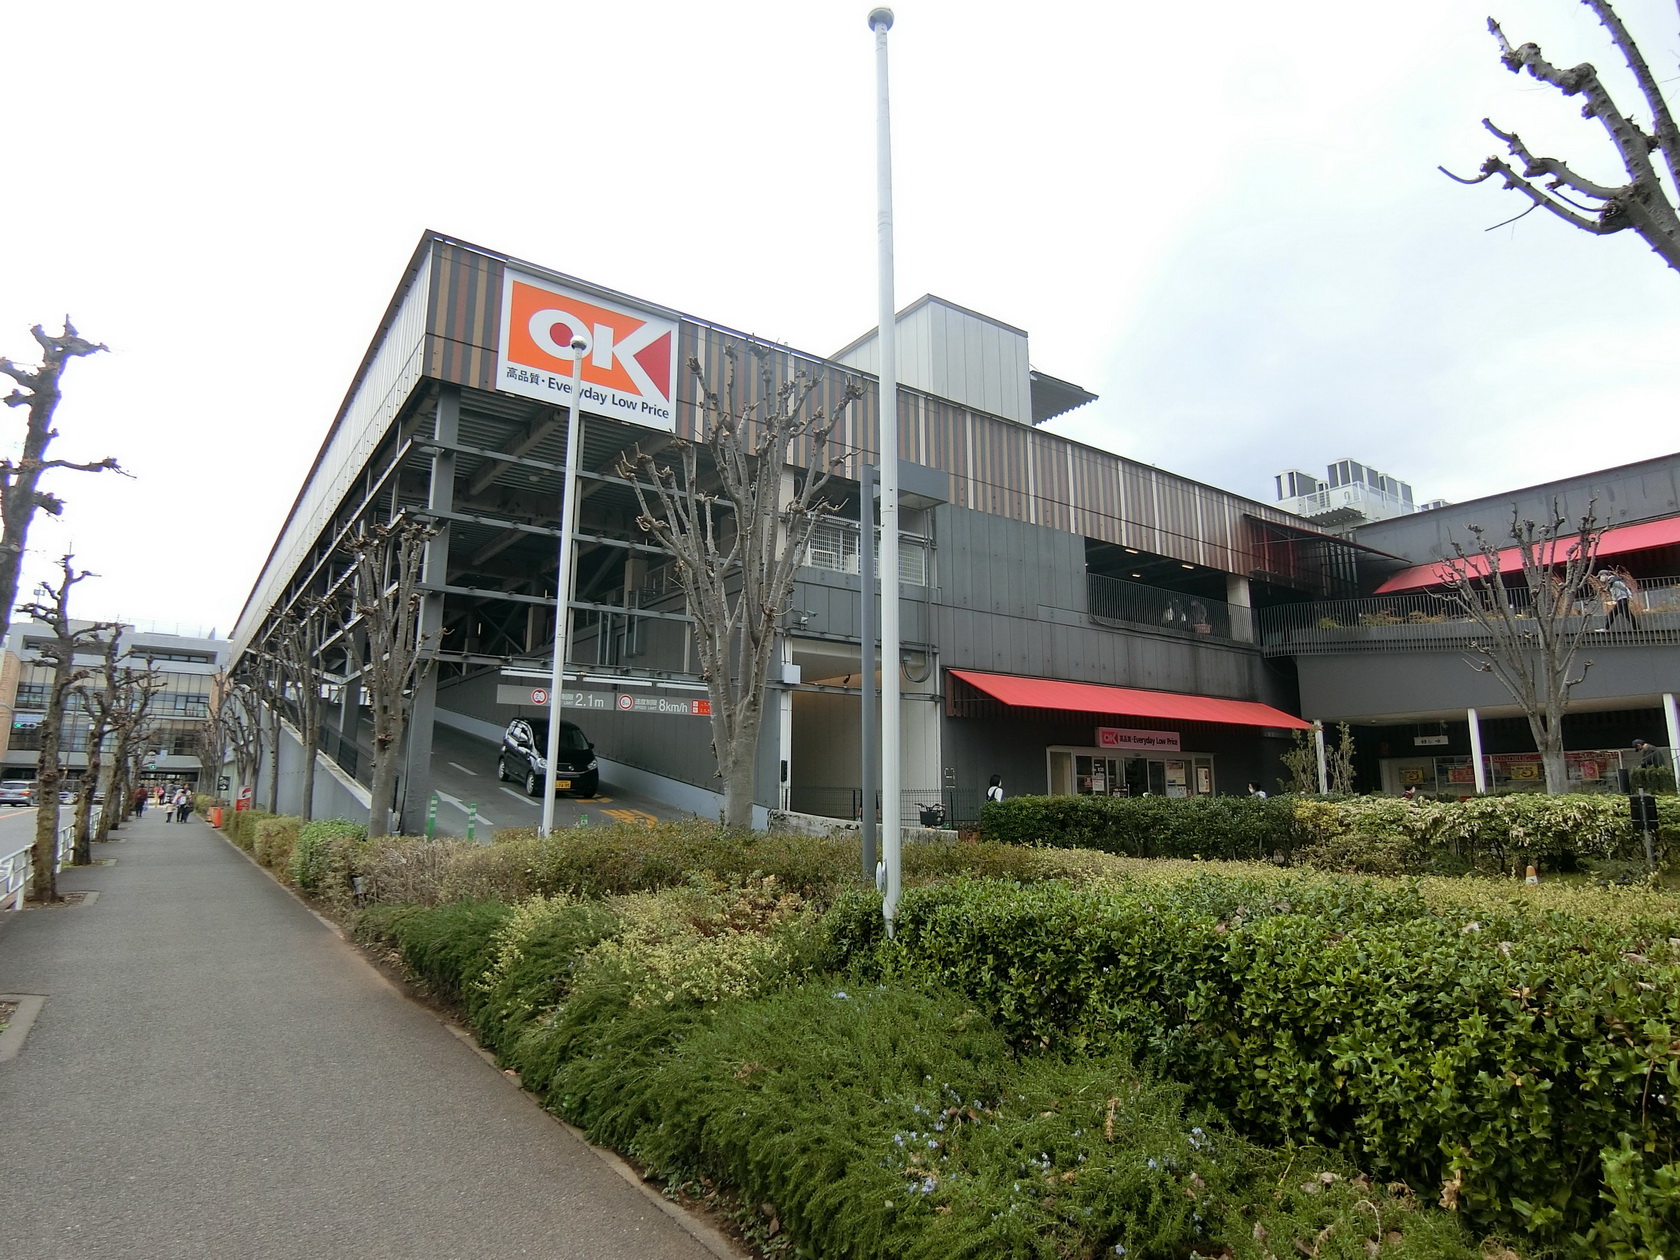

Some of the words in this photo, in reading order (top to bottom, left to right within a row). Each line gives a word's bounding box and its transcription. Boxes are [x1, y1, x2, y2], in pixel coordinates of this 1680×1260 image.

[529, 309, 671, 402] OK
[612, 394, 637, 410] Low
[641, 402, 670, 419] Price
[575, 693, 604, 708] 2.1m
[658, 699, 688, 713] 8km/h
[1104, 733, 1118, 744] OK
[1156, 737, 1166, 745] Low
[1167, 738, 1178, 746] Price
